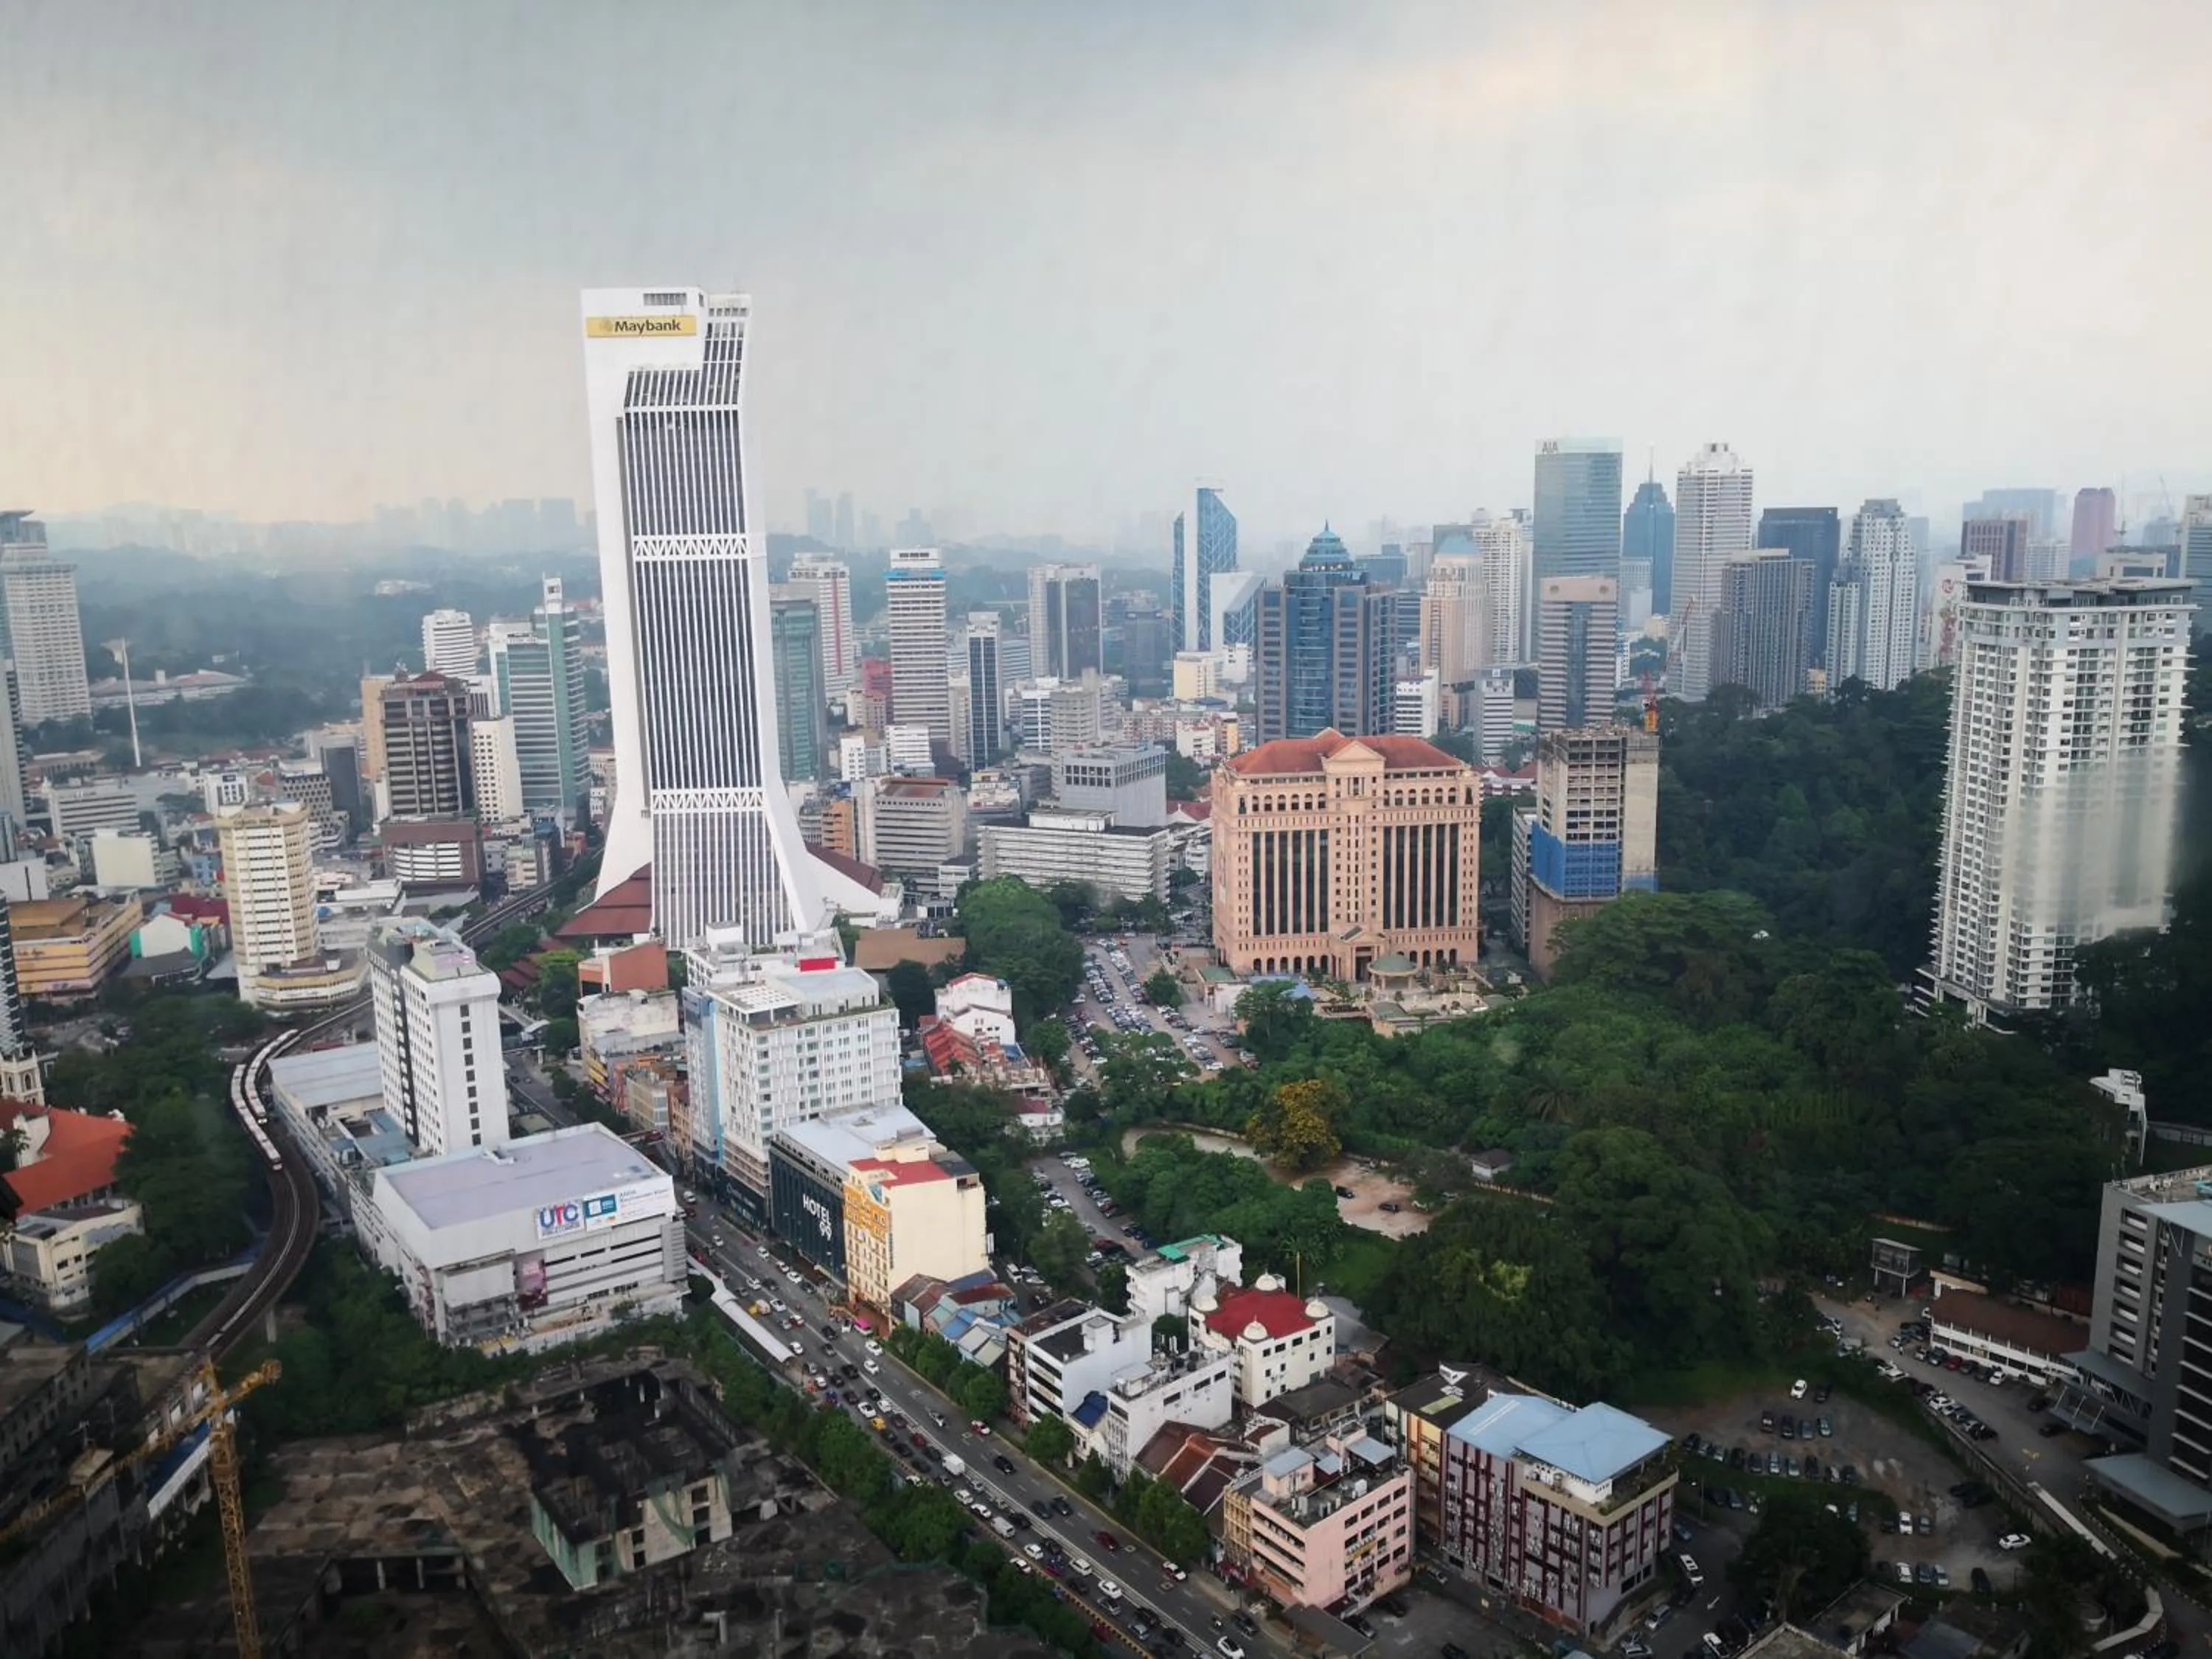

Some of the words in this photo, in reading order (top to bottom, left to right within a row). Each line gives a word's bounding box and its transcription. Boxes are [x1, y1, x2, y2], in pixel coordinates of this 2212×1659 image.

[614, 319, 681, 334] Maybank
[1542, 442, 1558, 455] AIA
[540, 1203, 578, 1228] UTC
[803, 1194, 831, 1226] HOTEL
[819, 1222, 832, 1241] 99
